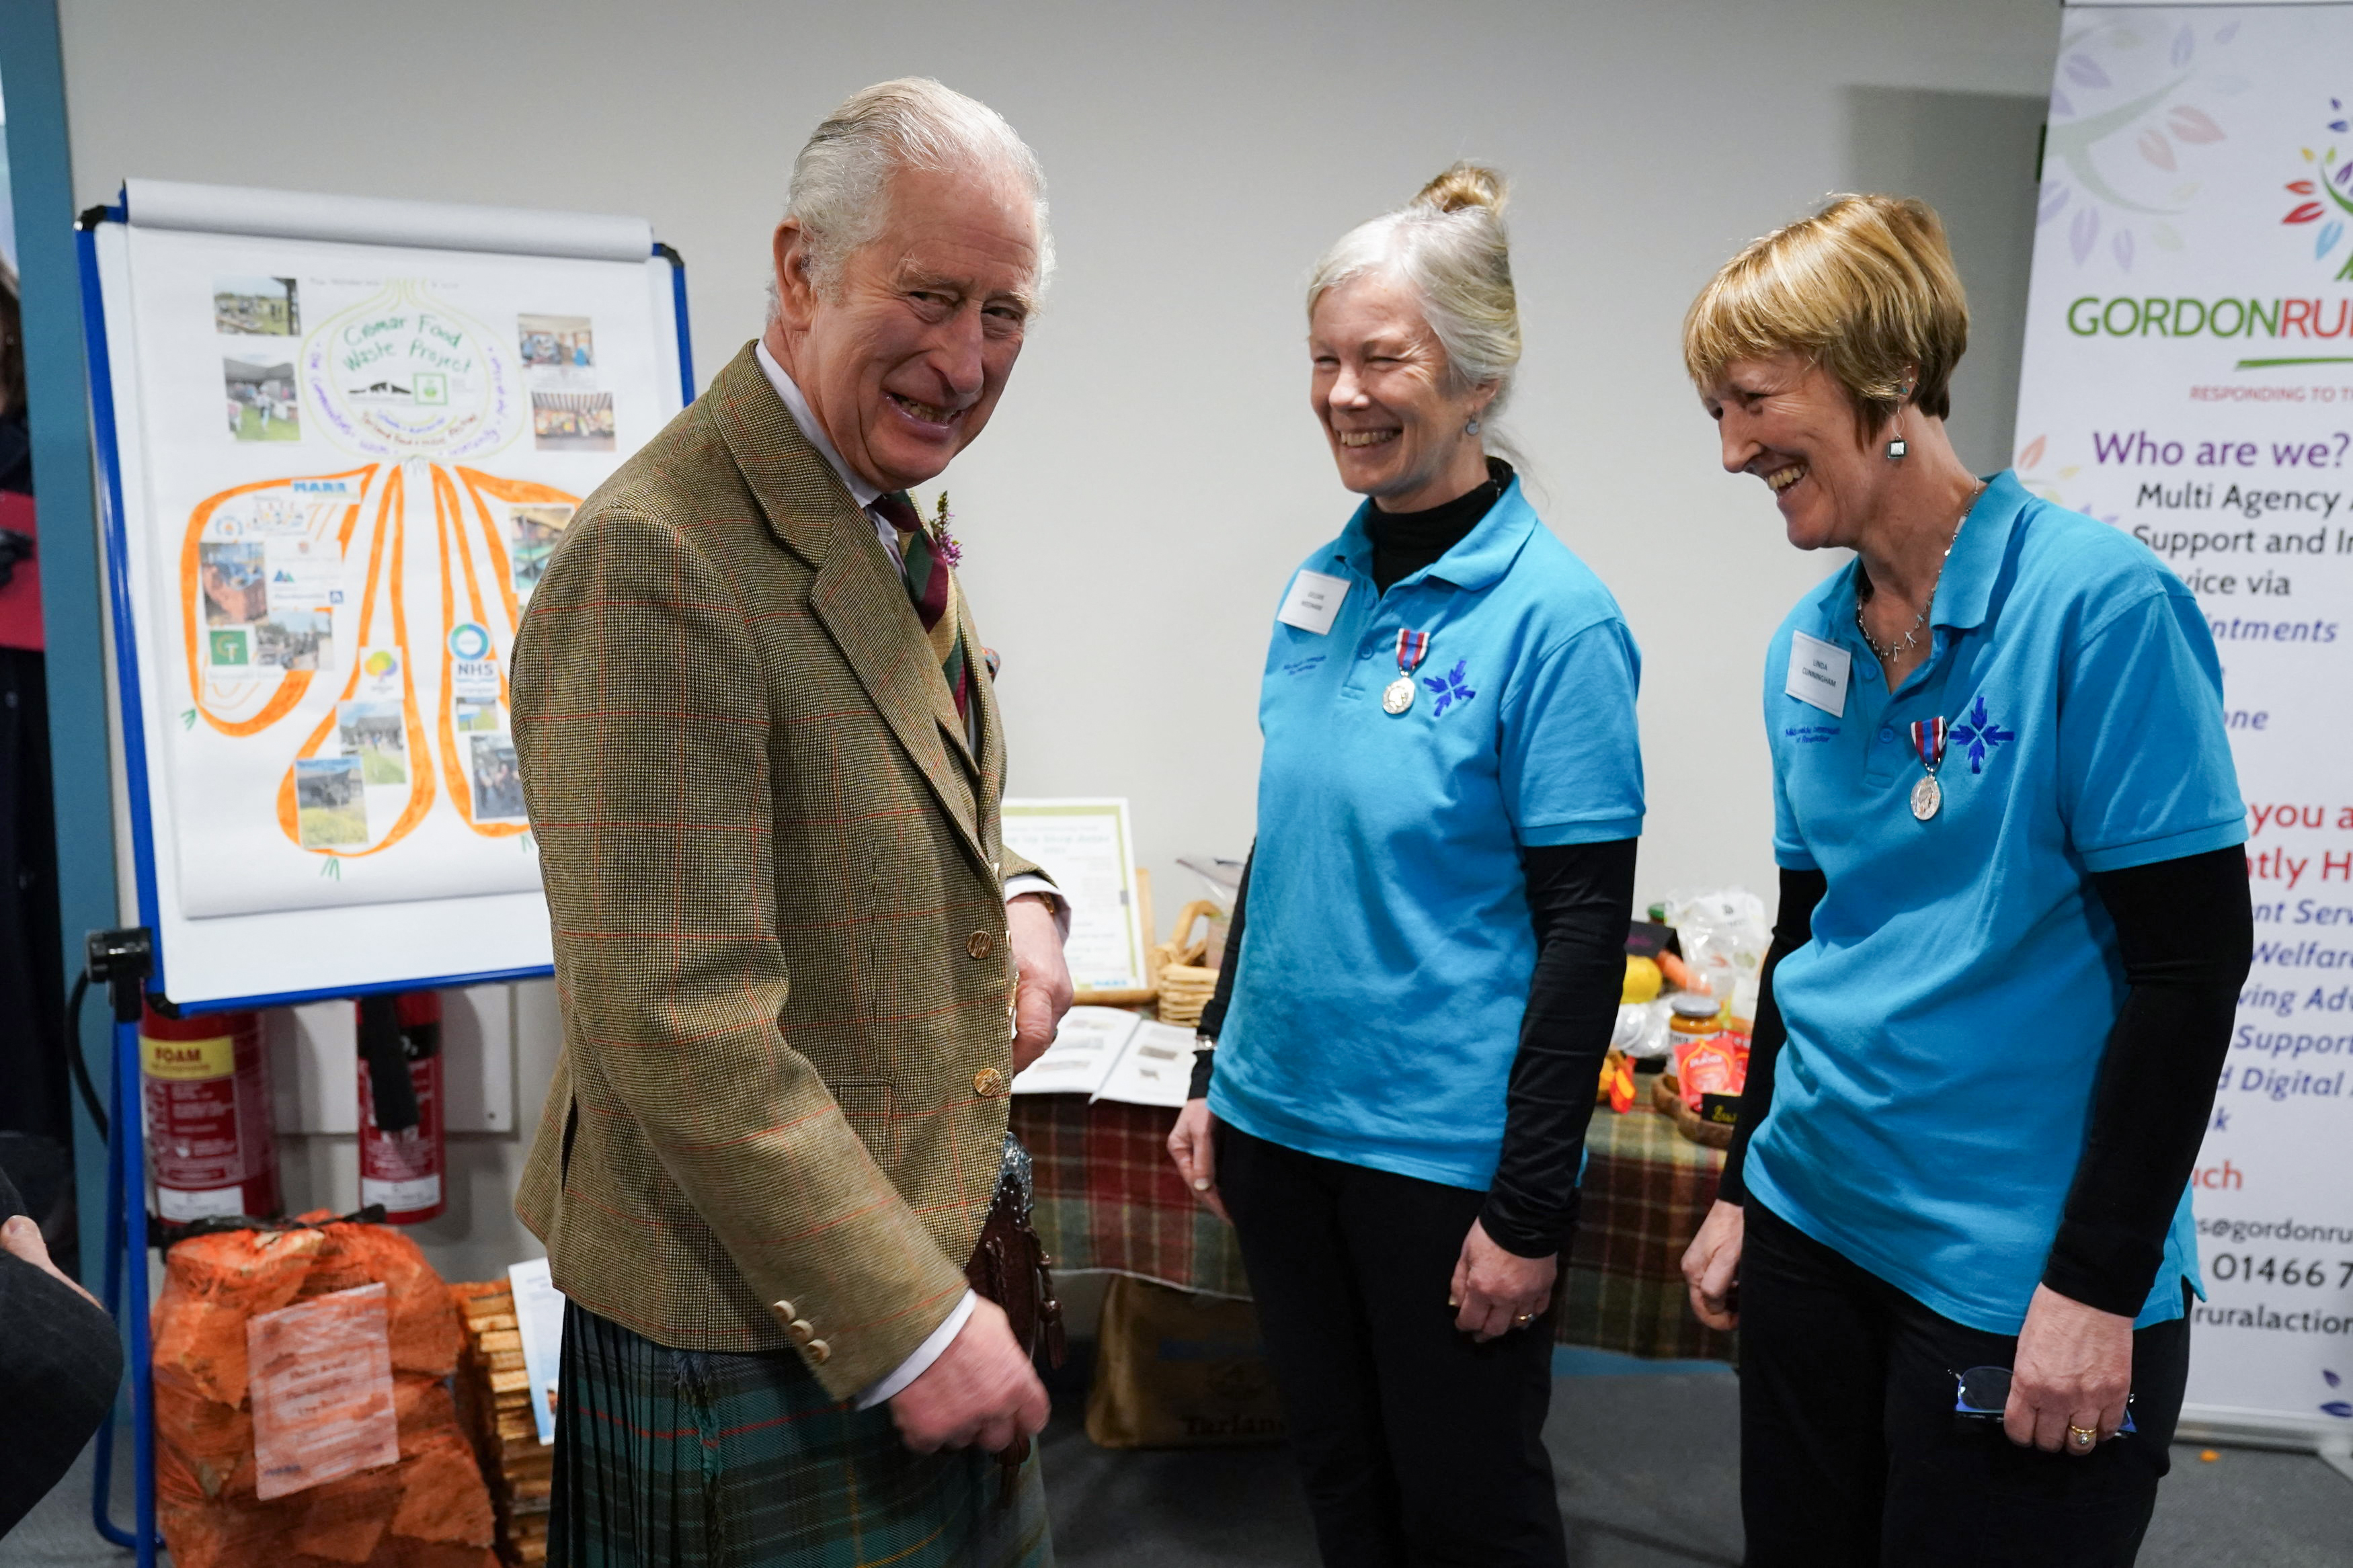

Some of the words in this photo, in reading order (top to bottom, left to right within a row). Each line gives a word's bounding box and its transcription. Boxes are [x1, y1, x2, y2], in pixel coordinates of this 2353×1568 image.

[418, 314, 463, 348] Food
[2067, 297, 2353, 338] GORDONRU
[344, 341, 396, 372] Waste
[409, 339, 471, 373] Project
[2189, 385, 2306, 402] RESPONDING
[2311, 386, 2336, 403] TO
[2342, 387, 2353, 403] T
[2093, 431, 2184, 466] Who
[2195, 442, 2258, 466] are
[2272, 432, 2351, 468] we?
[2136, 482, 2214, 509] Multi
[2221, 483, 2342, 519] Agency
[2132, 524, 2256, 559] Support
[2265, 526, 2327, 554] and
[2180, 568, 2237, 595] vice
[2247, 570, 2292, 596] via
[2208, 614, 2339, 643] ntments
[458, 663, 494, 676] NHS
[1802, 667, 1837, 688] CUNNINGHAM
[1813, 659, 1828, 671] LINDA
[2250, 804, 2324, 836] you
[2322, 851, 2353, 881] H
[2254, 903, 2284, 923] nt
[2252, 940, 2353, 968] Welfar
[2237, 983, 2296, 1018] ving
[2305, 986, 2353, 1012] Ad
[155, 1047, 201, 1063] FOAM
[2241, 1067, 2345, 1102] Digital
[2197, 1217, 2353, 1243] s@gordonru
[2212, 1253, 2325, 1287] 01466
[2193, 1304, 2353, 1334] ruralaction
